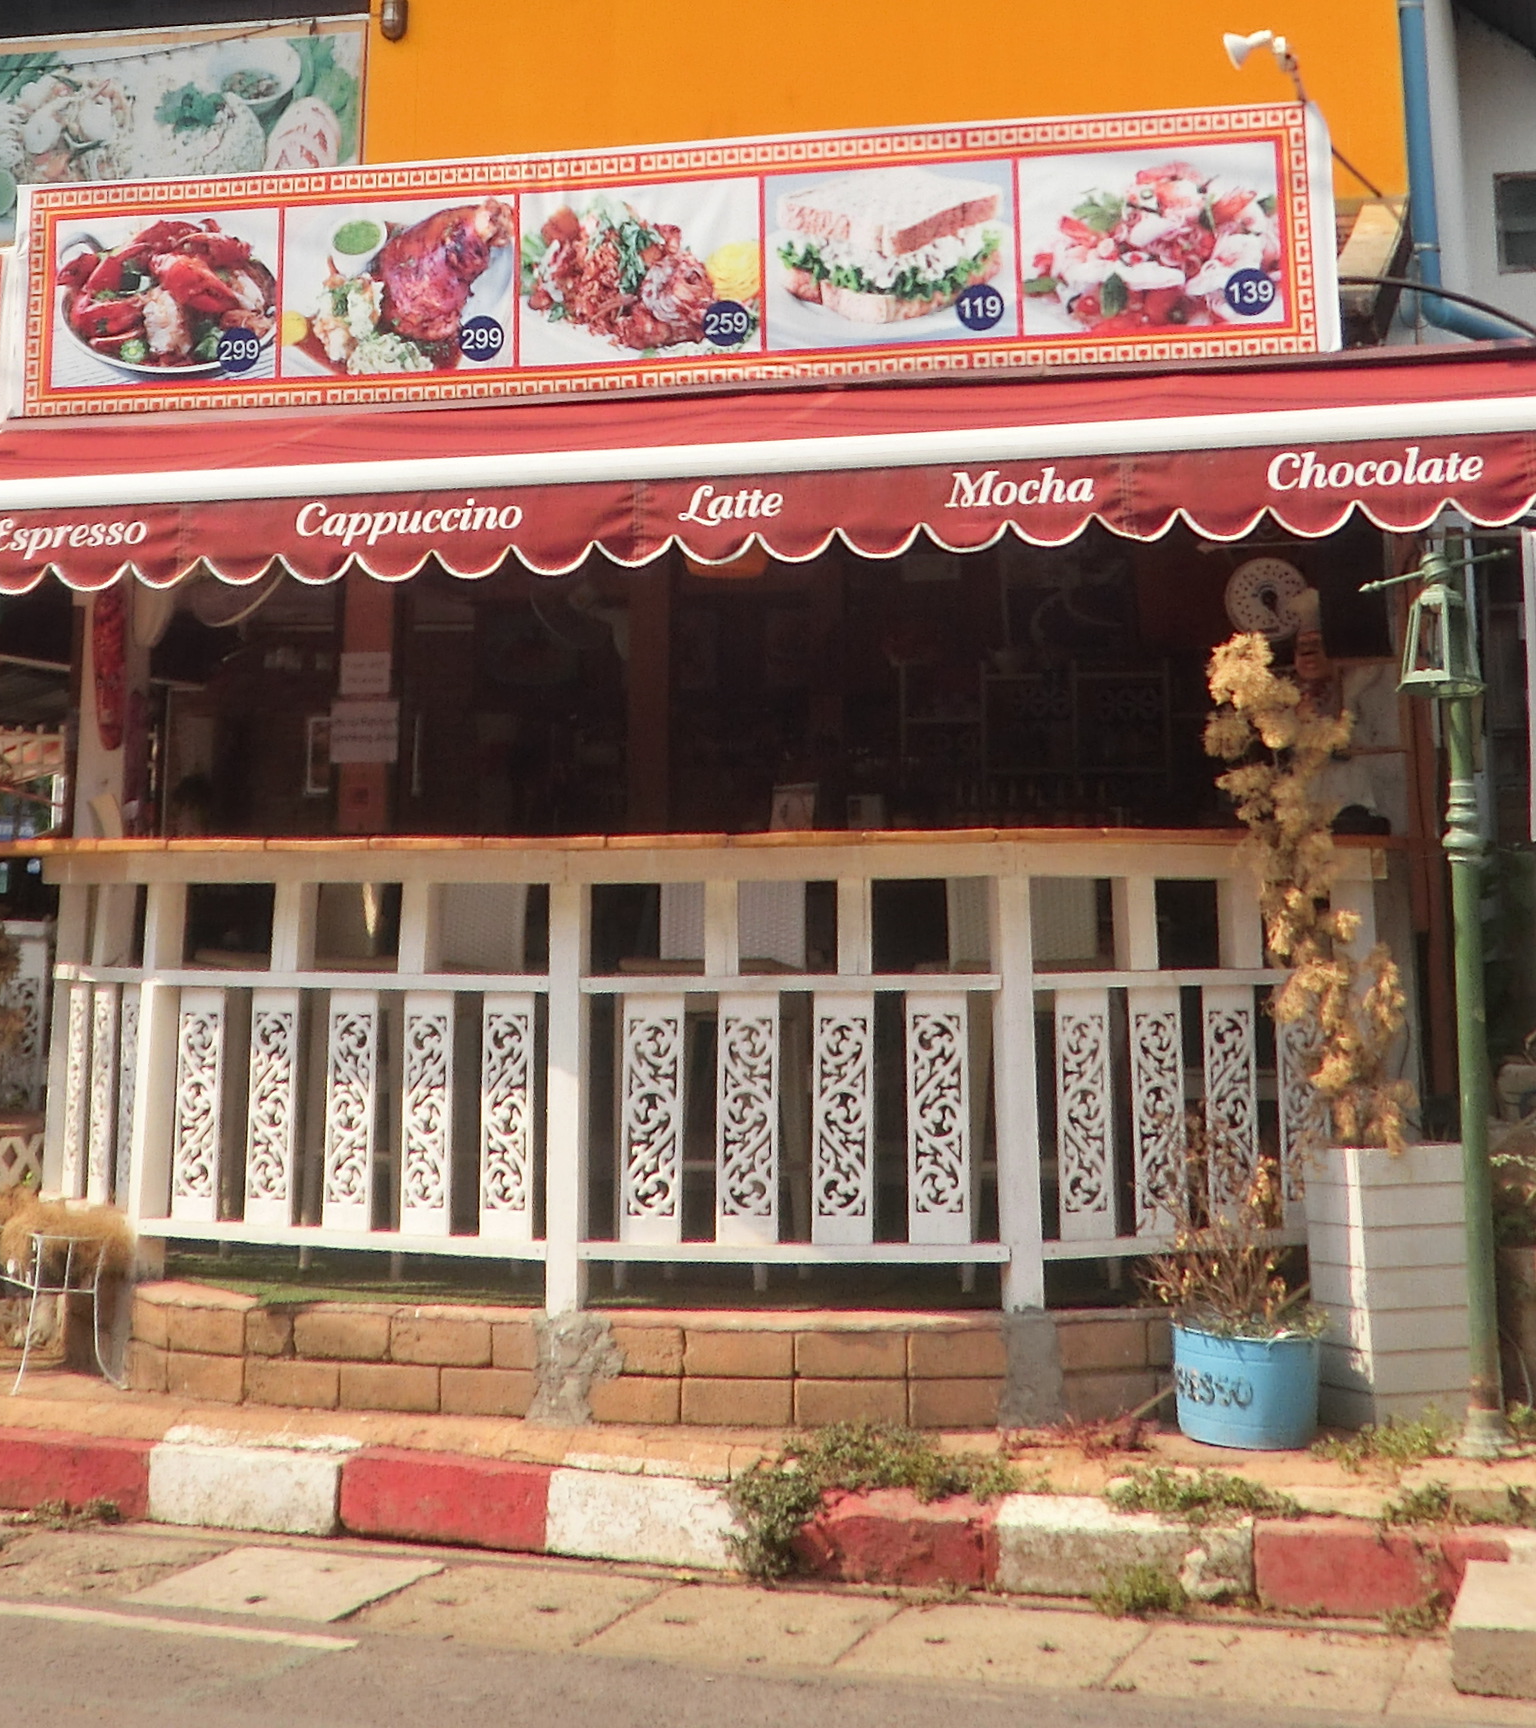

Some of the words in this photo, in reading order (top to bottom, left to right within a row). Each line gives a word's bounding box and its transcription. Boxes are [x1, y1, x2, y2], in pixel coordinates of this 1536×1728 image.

[1227, 279, 1275, 304] 139
[961, 295, 1002, 319] 119
[705, 311, 747, 335] 259
[219, 338, 259, 361] 299
[461, 327, 503, 350] 299
[1266, 446, 1484, 491] Chocolate
[944, 467, 1095, 509] Mocha
[678, 485, 784, 523] Latte
[295, 498, 523, 547] Cappuccino
